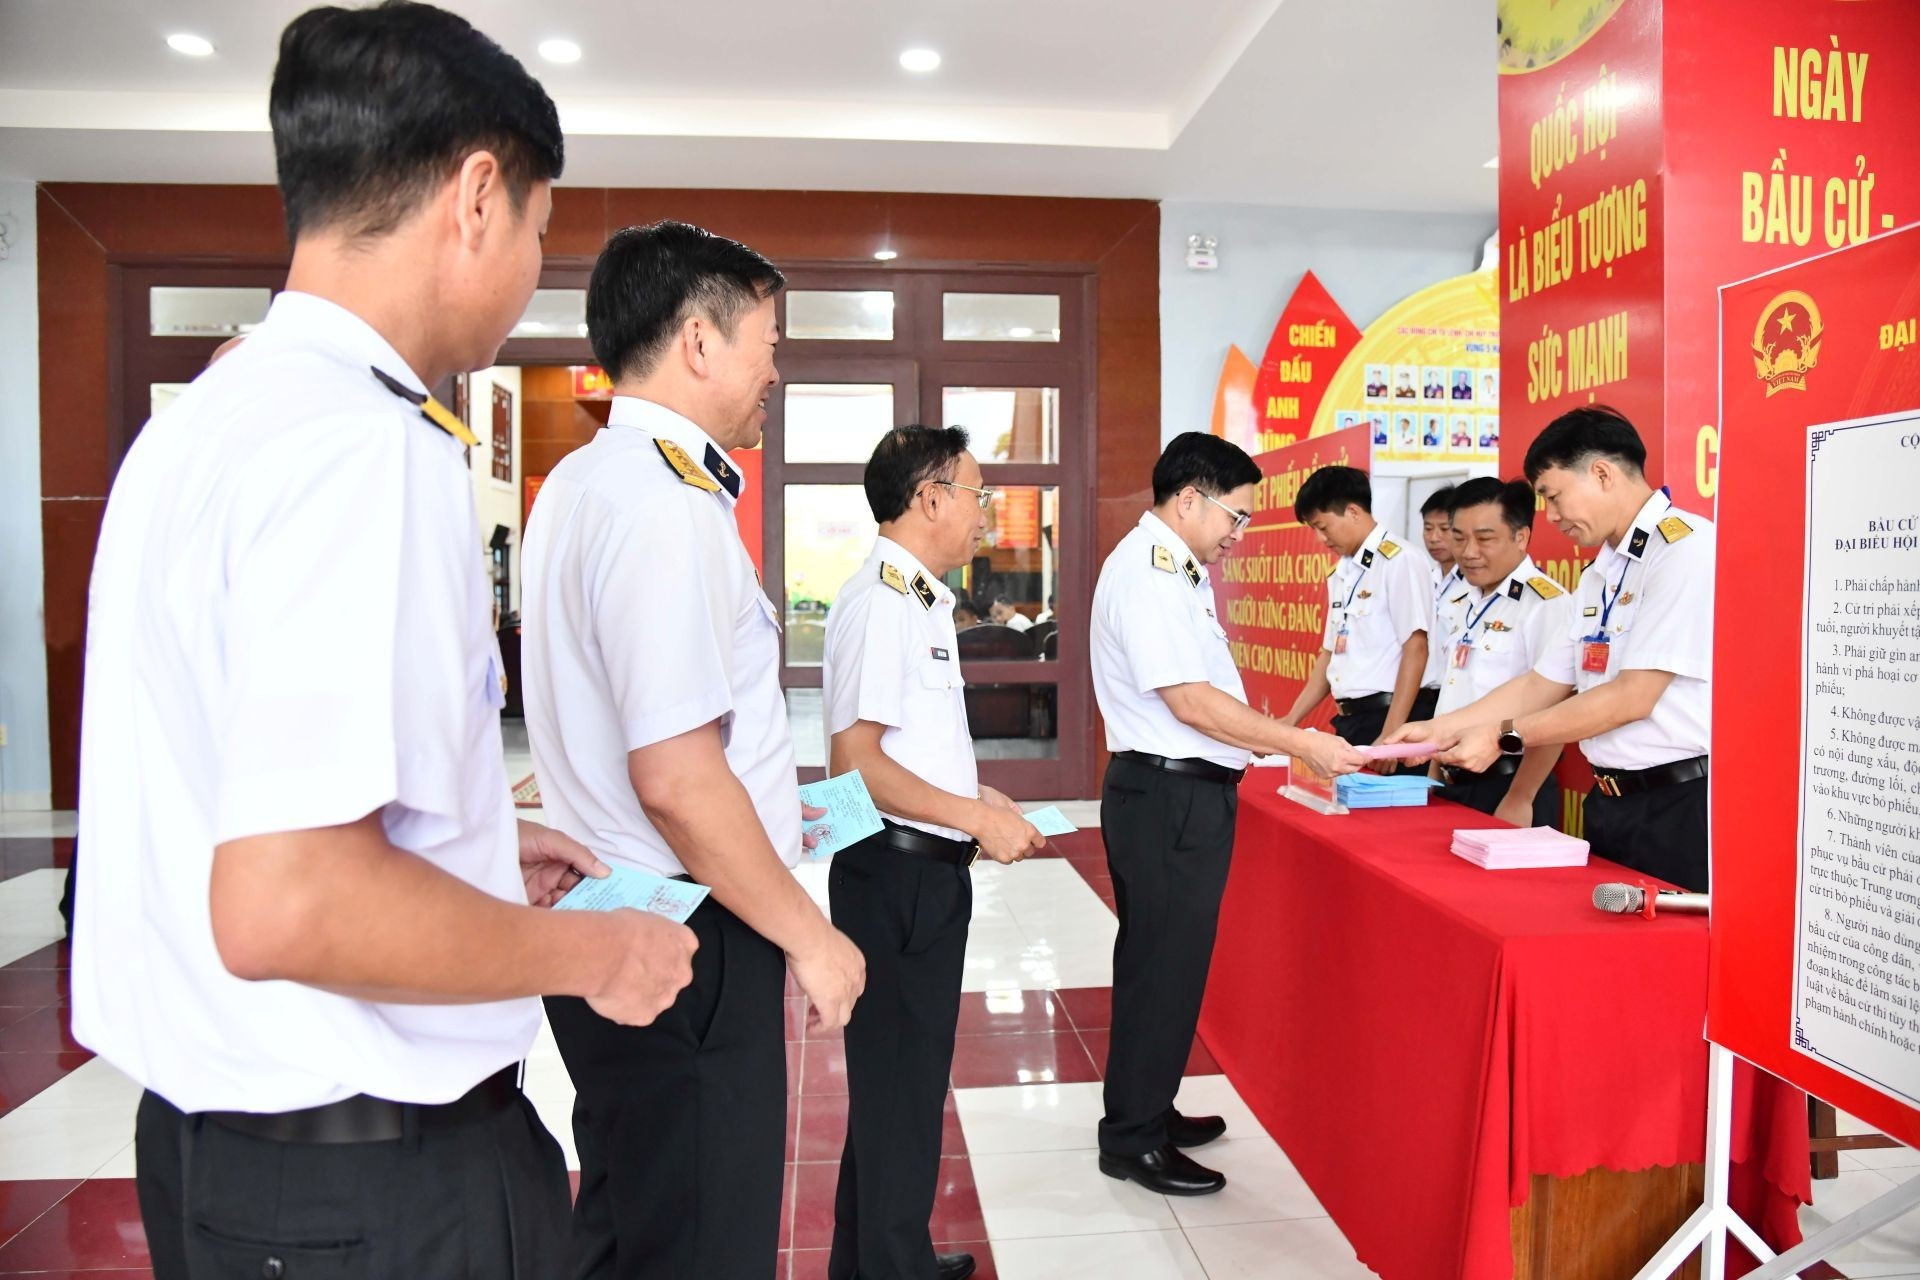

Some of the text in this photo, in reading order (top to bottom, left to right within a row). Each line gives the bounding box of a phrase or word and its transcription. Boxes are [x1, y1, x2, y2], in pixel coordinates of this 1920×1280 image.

[1773, 34, 1869, 123] NGÀY
[1530, 63, 1617, 190] QUỐC HỘI
[1742, 148, 1813, 247] BẦU
[1824, 154, 1875, 249] CỬ
[1509, 178, 1647, 303] LÀ BIỂU TƯỢNG
[1288, 319, 1337, 348] CHIẾN
[1879, 318, 1917, 352] ĐẠI
[1280, 353, 1312, 384] ĐẤU
[1527, 311, 1628, 404] SỨC MẠNH
[1266, 396, 1299, 419] ANH
[1898, 514, 1919, 531] CỬ
[1835, 533, 1918, 553] ĐẠI BIỂU HỘI
[1221, 543, 1331, 592] SÁNG SUỐT LỰA CHỌN
[1834, 579, 1843, 591] 1.
[1845, 576, 1867, 591] Phải
[1869, 575, 1894, 595] chấp
[1226, 592, 1322, 634] NGƯỜI XỨNG ĐÁNG
[1833, 601, 1842, 614] 2.
[1845, 602, 1861, 615] Cử
[1863, 602, 1875, 615] tri
[1877, 602, 1900, 619] phải
[1816, 617, 1839, 635] tuổi,
[1840, 621, 1871, 638] người
[1872, 620, 1909, 640] khuyết
[1251, 644, 1273, 674] CHO
[1274, 643, 1306, 680] NHÂN
[1832, 643, 1841, 657] 3.
[1844, 644, 1866, 658] Phải
[1868, 645, 1887, 662] giữ
[1888, 647, 1907, 664] gìn
[1815, 679, 1845, 697] phiếu;
[1816, 661, 1918, 684] hành vi phá hoại cơ
[1830, 705, 1840, 718] 4.
[1842, 706, 1877, 726] Không
[1877, 711, 1906, 728] được
[1830, 727, 1839, 741] 5.
[1841, 729, 1876, 750] Không
[1878, 735, 1906, 752] được
[1813, 745, 1825, 757] có
[1828, 747, 1844, 762] nội
[1847, 750, 1873, 769] dung
[1877, 752, 1900, 772] xấu,
[1812, 783, 1830, 796] vào
[1831, 785, 1850, 800] khu
[1851, 792, 1871, 806] vực
[1872, 793, 1886, 808] bỏ
[1813, 765, 1848, 783] trương,
[1851, 770, 1885, 791] đường
[1889, 774, 1907, 794] lối,
[1827, 807, 1836, 821] 6.
[1838, 809, 1874, 832] Những
[1875, 821, 1907, 836] người
[1827, 829, 1836, 843] 7.
[1839, 832, 1872, 852] Thành
[1875, 842, 1898, 859] viên
[1810, 845, 1834, 862] phục
[1837, 854, 1849, 868] vụ
[1851, 853, 1870, 871] bầu
[1872, 862, 1887, 876] cử
[1889, 866, 1913, 884] phải
[1810, 865, 1829, 879] trực
[1830, 869, 1859, 888] thuộc
[1860, 877, 1893, 901] Trung
[1809, 882, 1822, 895] cử
[1822, 887, 1833, 899] tri
[1835, 888, 1848, 904] bỏ
[1849, 895, 1878, 913] phiếu
[1880, 904, 1893, 918] và
[1894, 908, 1915, 926] giải
[1824, 907, 1833, 922] 8.
[1836, 911, 1868, 934] Người
[1871, 925, 1891, 941] nào
[1808, 920, 1915, 972] bầu cử của công dân,
[1807, 941, 1837, 960] nhiệm
[1839, 953, 1866, 975] trong
[1866, 964, 1893, 985] công
[1895, 973, 1911, 989] tác
[1806, 958, 1830, 977] đoạn
[1831, 966, 1855, 987] khác
[1855, 976, 1868, 992] để
[1870, 982, 1890, 1002] làm
[1891, 993, 1907, 1008] sai
[1806, 975, 1824, 994] luật
[1825, 983, 1837, 999] về
[1838, 988, 1857, 1007] bầu
[1857, 1000, 1872, 1013] cử
[1805, 996, 1832, 1016] phạm
[1833, 1005, 1857, 1027] hành
[1858, 1019, 1888, 1041] chính
[1889, 1029, 1916, 1052] hoặc
